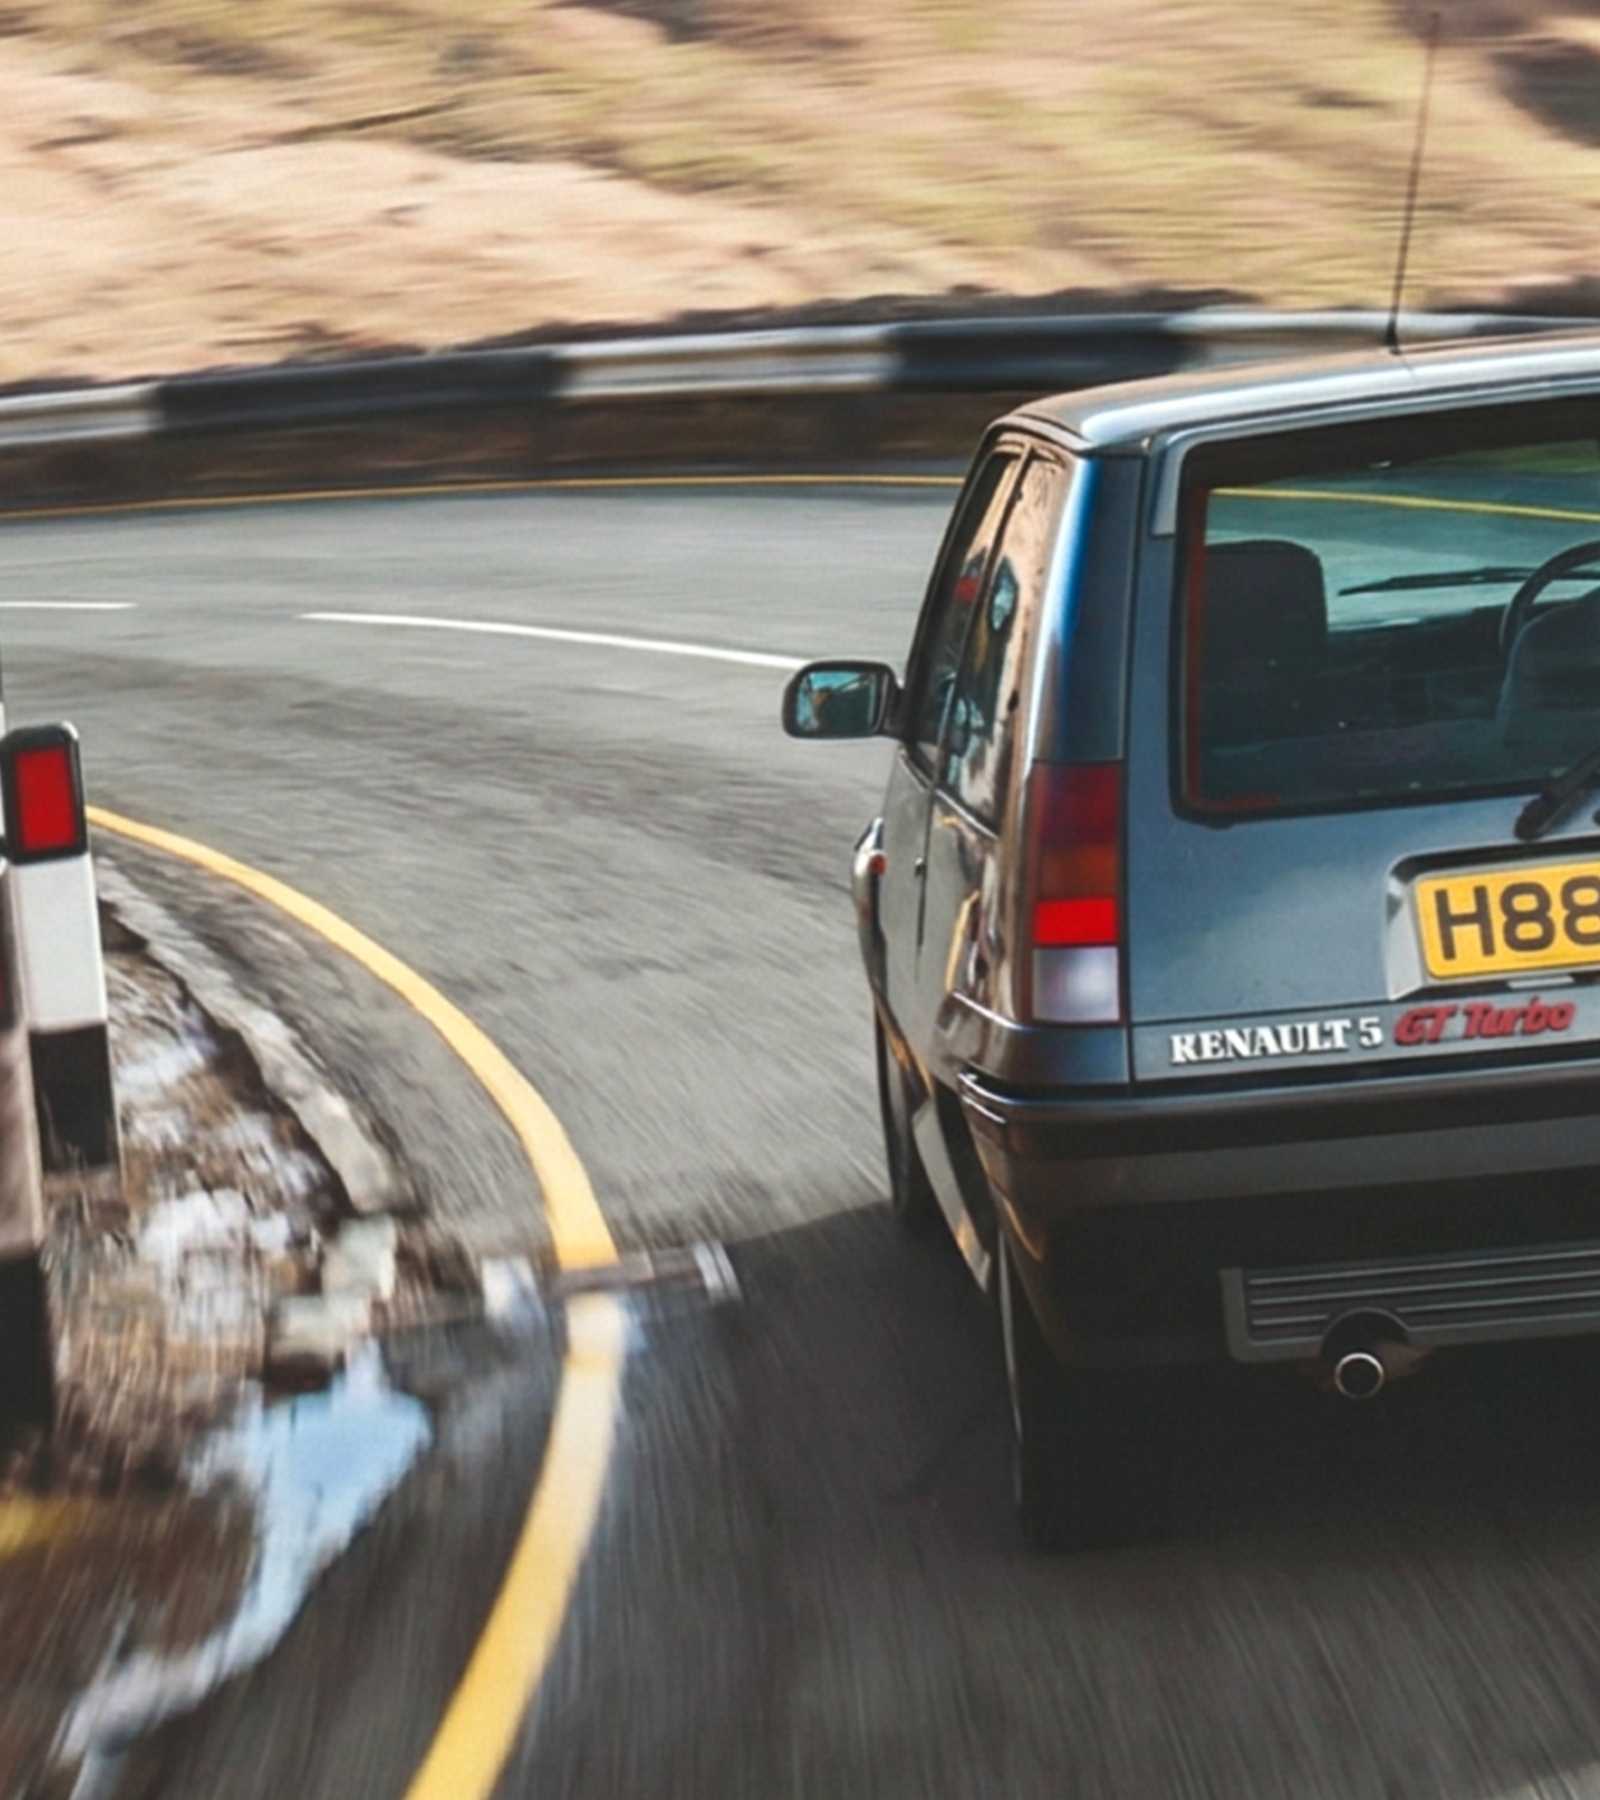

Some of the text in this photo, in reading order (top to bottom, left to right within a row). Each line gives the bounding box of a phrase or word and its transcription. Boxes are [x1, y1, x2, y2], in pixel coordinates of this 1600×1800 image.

[1171, 995, 1576, 1064] RENAULT 5 GT Turbo
